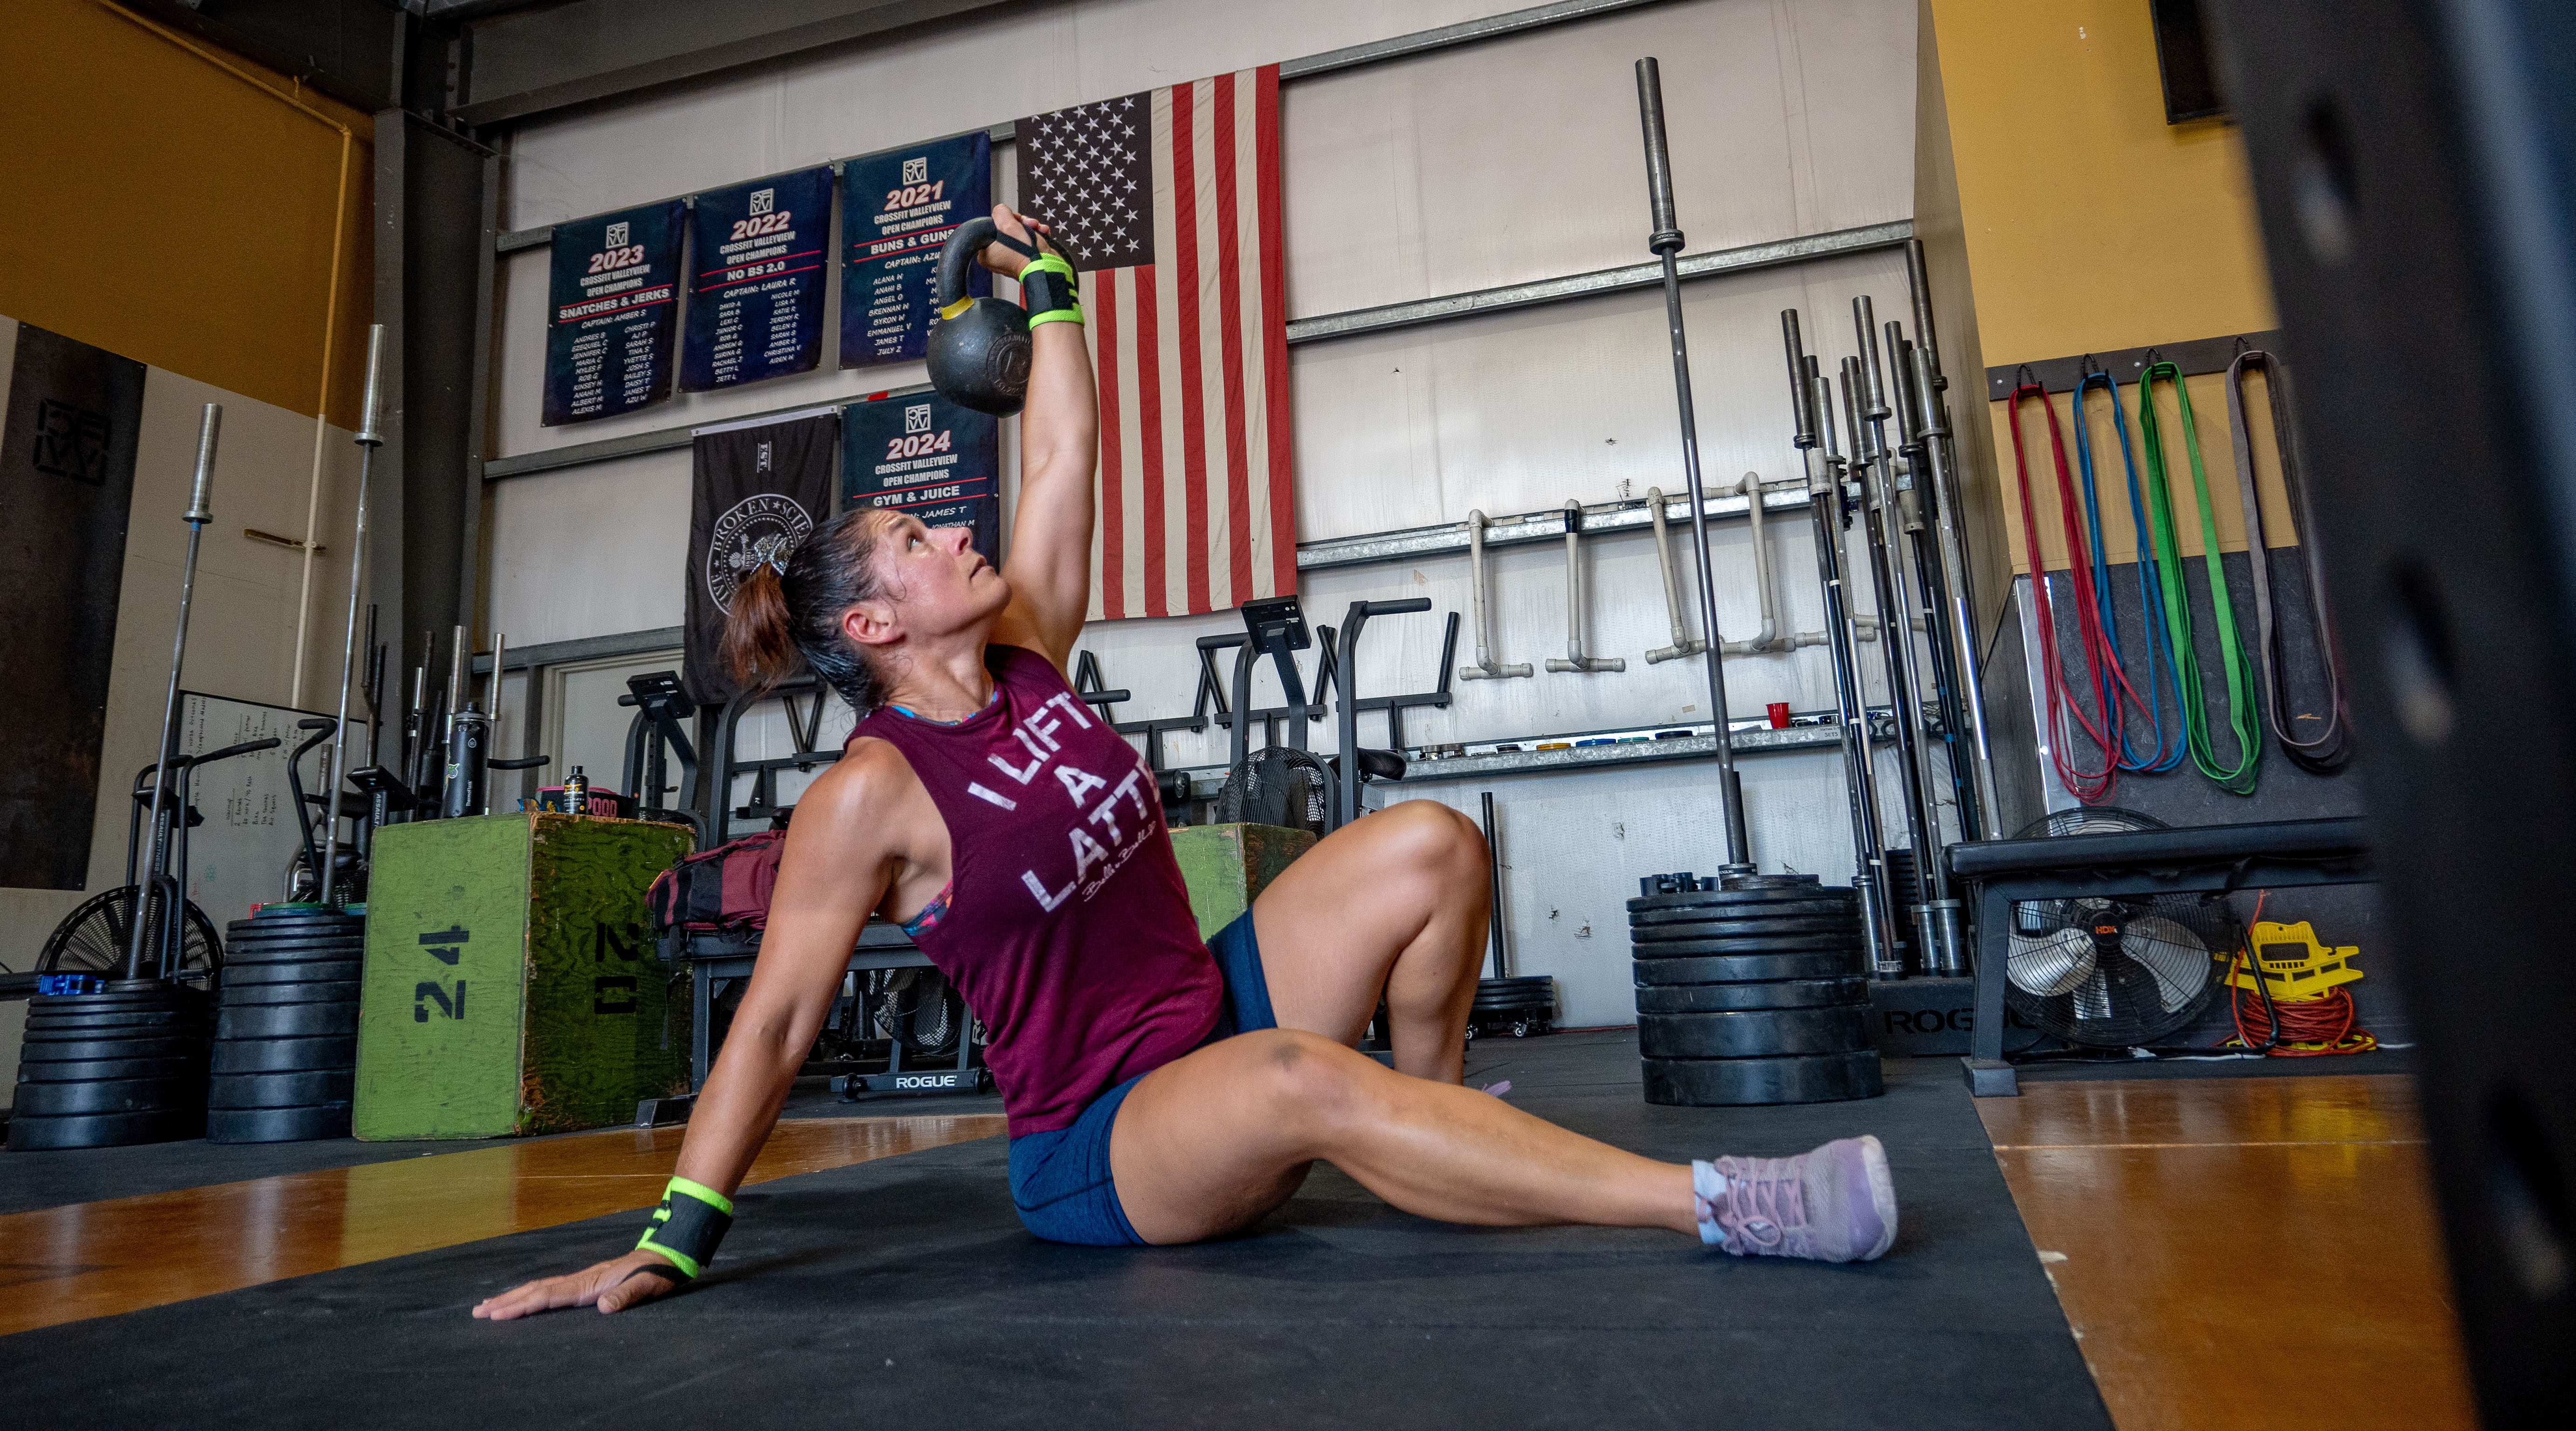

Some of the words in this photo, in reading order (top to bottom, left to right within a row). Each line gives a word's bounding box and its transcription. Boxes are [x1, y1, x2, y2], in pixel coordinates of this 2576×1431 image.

[884, 180, 944, 211] 2021
[874, 210, 908, 224] CROSSFIT
[909, 200, 951, 217] VALLEYVIEW
[731, 211, 790, 240] 2022
[882, 224, 900, 235] OPEN
[901, 214, 943, 231] CHAMPIONS
[720, 240, 753, 254] CROSSFIT
[754, 231, 795, 247] VALLEYVIEW
[871, 240, 904, 254] BUNS
[907, 237, 916, 247] &
[588, 245, 644, 273] 2023
[727, 254, 745, 264] OPEN
[746, 245, 787, 261] CHAMPIONS
[885, 256, 921, 269] CAPTAIN:
[580, 272, 612, 286] CROSSFIT
[612, 264, 650, 279] VALLEYVIEW
[727, 270, 745, 281] NO
[748, 265, 763, 277] BS
[767, 261, 785, 273] 2.0
[873, 275, 894, 285] ALANA
[587, 286, 604, 297] OPEN
[604, 278, 642, 293] CHAMPIONS
[724, 286, 759, 298] CAPTAIN:
[761, 280, 787, 290] LAURA
[874, 285, 895, 295] ANAHI
[771, 291, 792, 299] NICOLE
[874, 296, 896, 305] ANGEL
[559, 299, 618, 318] SNATCHES
[621, 297, 629, 306] &
[632, 289, 669, 304] JERKS
[869, 304, 901, 316] BRENNAN
[581, 317, 613, 328] CAPTAIN:
[614, 311, 639, 321] AMBER
[769, 315, 793, 324] JEREMY
[873, 316, 897, 325] BYRON
[867, 325, 904, 337] EMMANUEL
[574, 333, 599, 343] ANDRES
[625, 339, 647, 348] SARAH
[875, 337, 897, 346] JAMES
[713, 341, 737, 351] ANDREW
[764, 346, 794, 357] CHRISTINA
[571, 349, 601, 359] JENNIFER
[624, 354, 648, 364] YVETTE
[576, 358, 595, 366] MARIA
[627, 363, 643, 372] JOSH
[712, 358, 736, 366] RACHAEL
[576, 366, 596, 374] MYLES
[624, 371, 646, 380] BAILEY
[573, 381, 596, 390] KINSEY
[625, 379, 643, 388] DAISY
[574, 390, 594, 398] ANAHI
[623, 387, 644, 396] JAMES
[571, 397, 596, 407] ALBERT
[572, 406, 594, 414] ALEXIS
[886, 430, 950, 459] 2024
[760, 444, 768, 470] EST.
[875, 461, 912, 475] CROSSFIT
[912, 454, 957, 469] VALLEYVIEW
[884, 476, 903, 487] OPEN
[904, 469, 949, 484] CHAMPIONS
[874, 494, 902, 506] GYM
[907, 492, 916, 502] &
[920, 485, 960, 500] JUICE
[922, 508, 956, 518] JAMES
[714, 498, 770, 551] BROKEN
[987, 691, 1092, 786] LIFT
[1054, 765, 1107, 809] A
[967, 781, 1017, 811] I
[2095, 926, 2115, 934] HDX
[414, 925, 470, 1023] 24
[1885, 1008, 2038, 1034] ROGE
[896, 1075, 956, 1088] ROGUE
